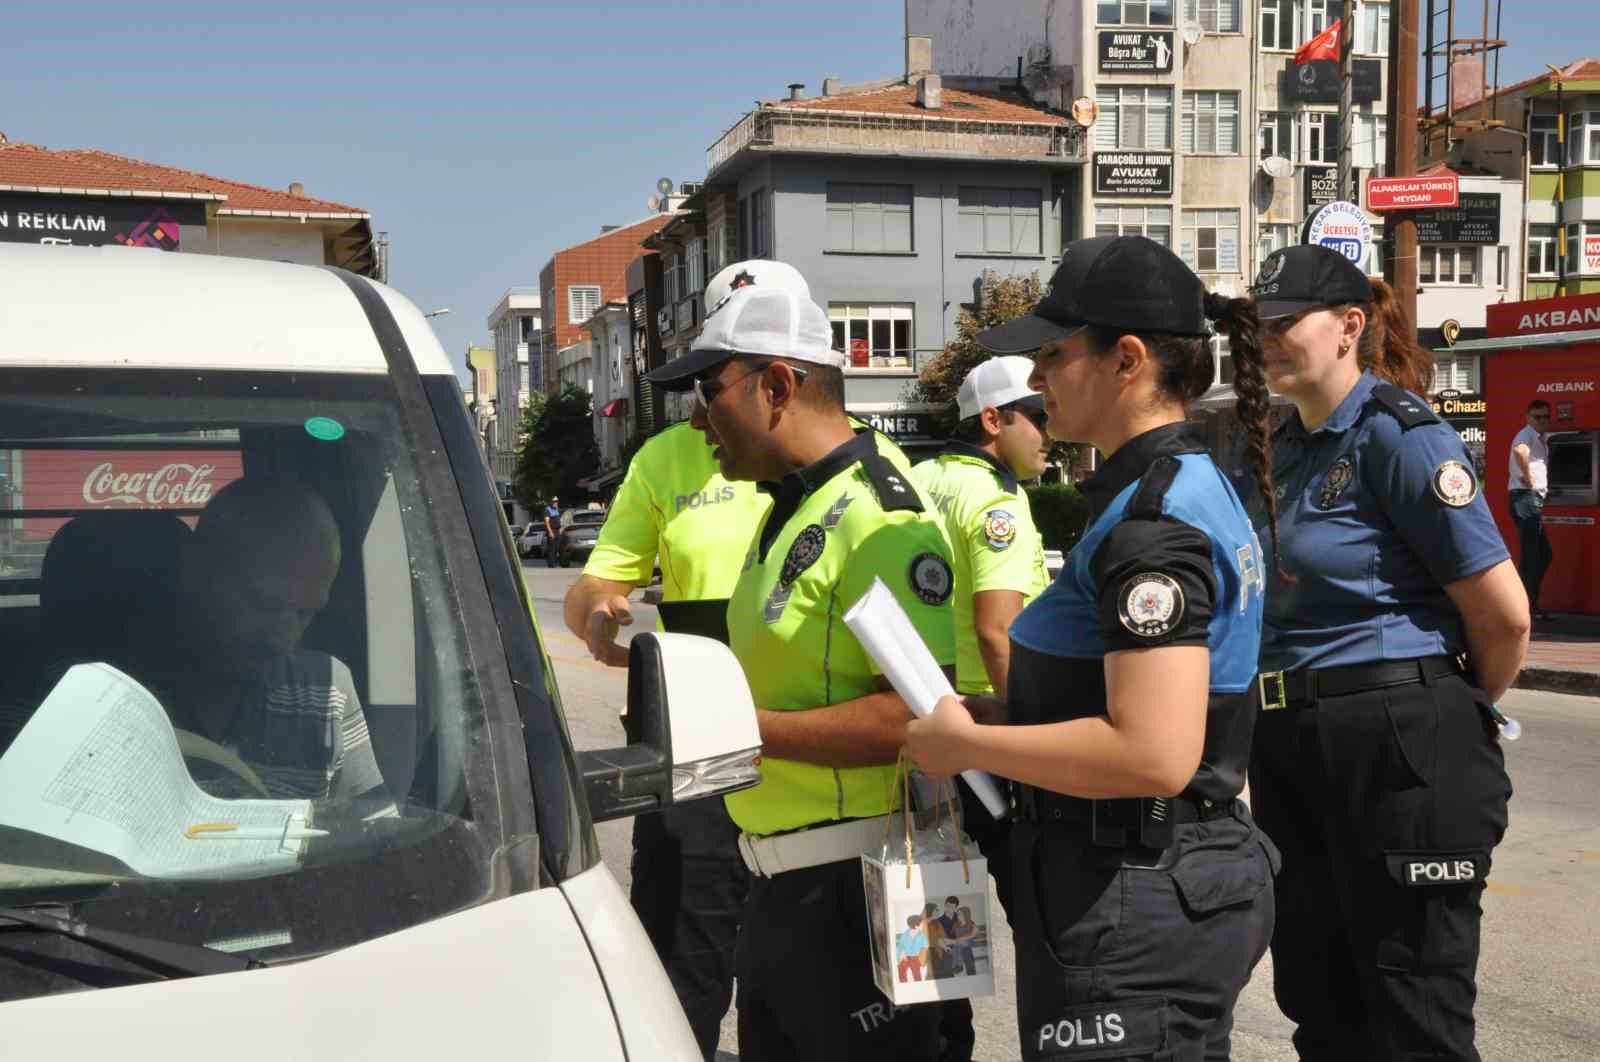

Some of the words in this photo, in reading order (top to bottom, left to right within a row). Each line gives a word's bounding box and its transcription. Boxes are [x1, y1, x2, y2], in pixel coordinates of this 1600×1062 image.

[1113, 34, 1141, 45] AVUKAT
[1097, 153, 1143, 166] SARAÇOĞLU
[1145, 155, 1172, 165] HUKUK
[1111, 167, 1158, 177] AVUKAT
[1371, 184, 1420, 192] ALPARSLAN
[1421, 181, 1455, 191] TÜRKEŞ
[1393, 194, 1431, 202] MEYDANI
[17, 212, 106, 232] REKLAM
[1323, 223, 1359, 235] ÜCRETSİZ
[1536, 382, 1594, 393] AKBANK
[83, 462, 216, 504] Coca-Cola
